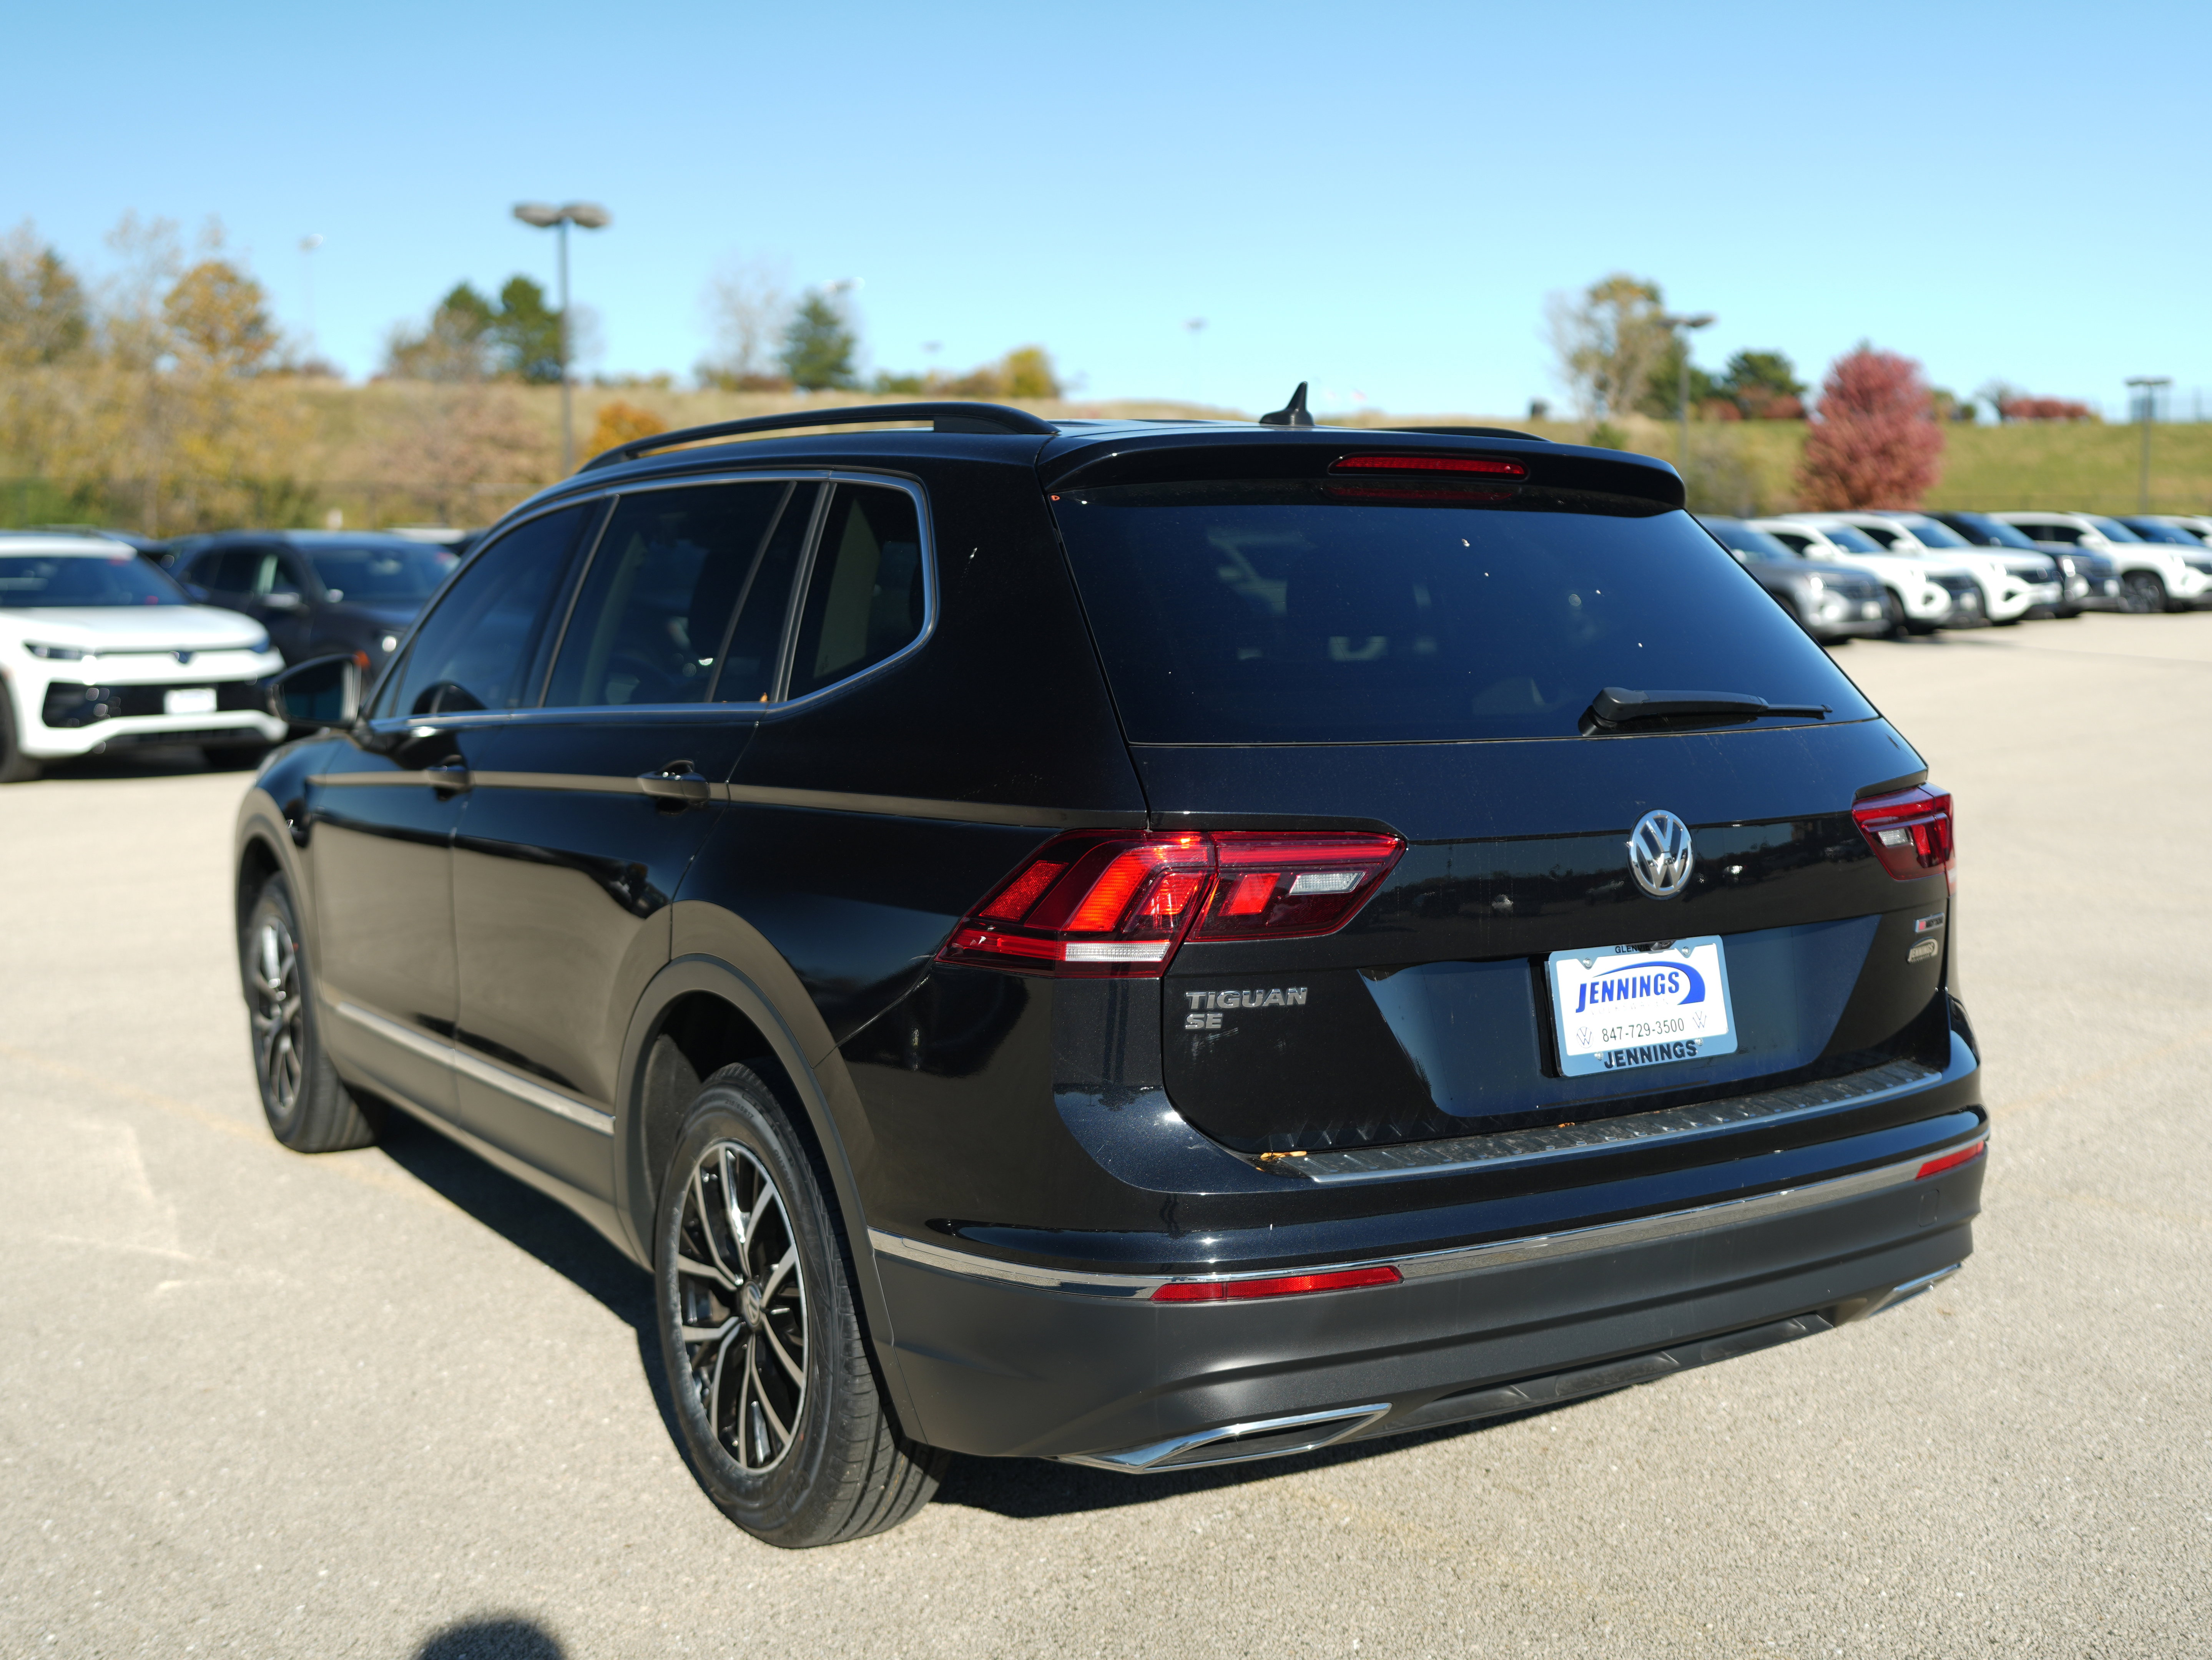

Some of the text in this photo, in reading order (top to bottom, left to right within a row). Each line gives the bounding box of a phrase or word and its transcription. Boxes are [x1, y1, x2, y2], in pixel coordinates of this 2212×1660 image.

[1615, 944, 1651, 954] GLENVIE
[1186, 987, 1307, 1010] TIGUAN
[1575, 971, 1680, 1013] JENNINGS
[1185, 1013, 1223, 1030] SE
[1602, 1018, 1684, 1042] 847-729-3500
[1604, 1040, 1698, 1069] JENNINGS
